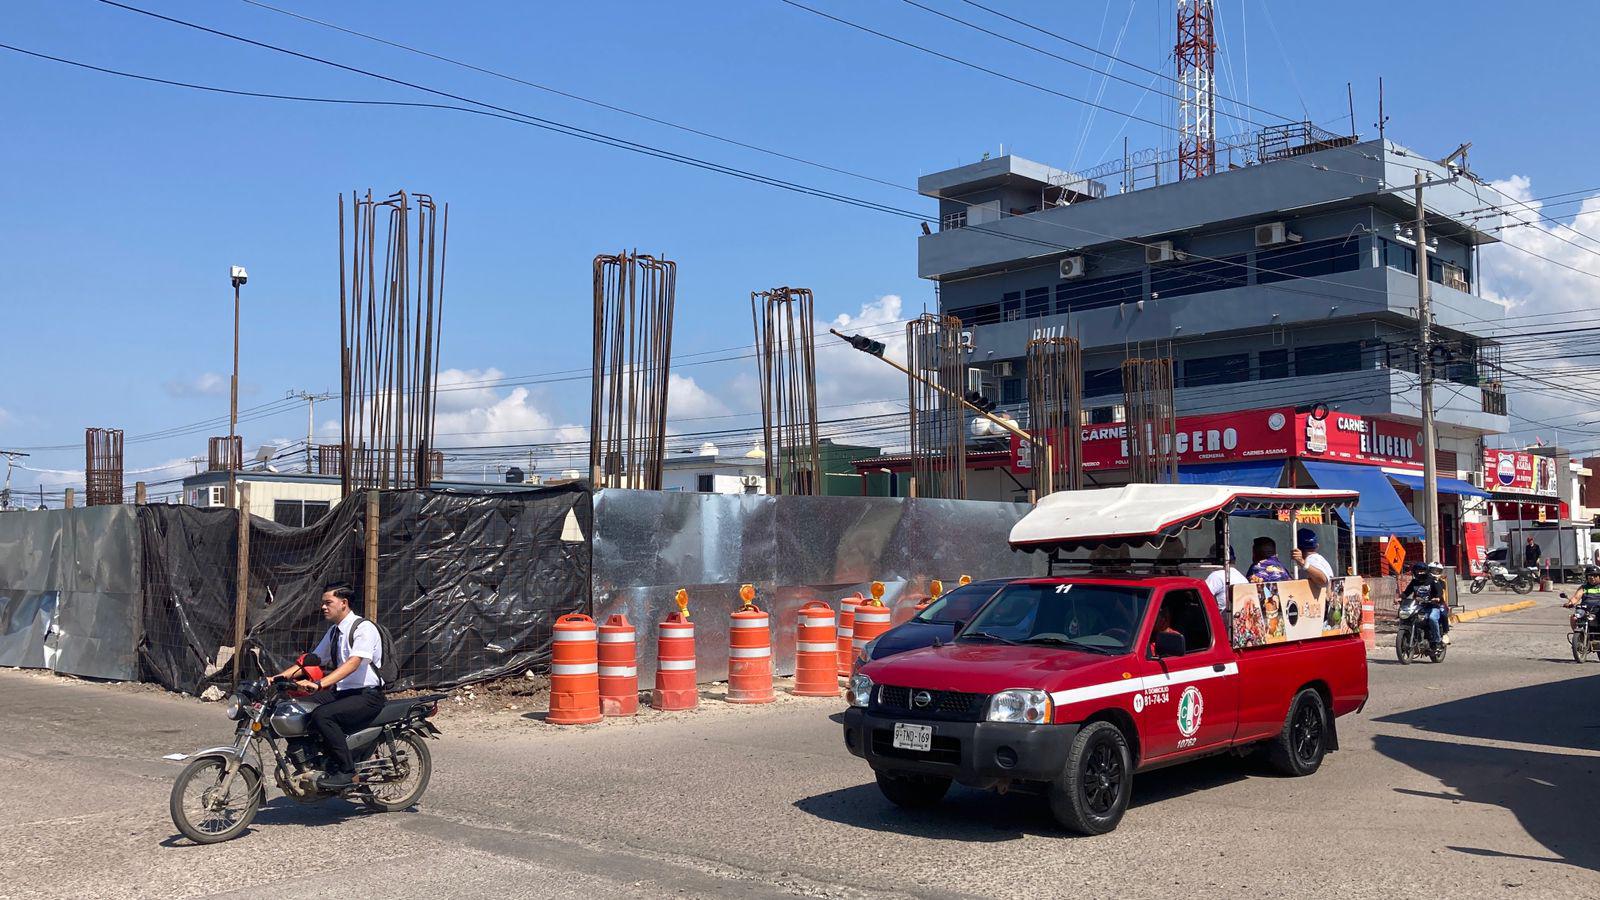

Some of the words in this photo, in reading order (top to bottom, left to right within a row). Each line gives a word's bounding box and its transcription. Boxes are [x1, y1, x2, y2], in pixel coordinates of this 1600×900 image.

[1338, 417, 1368, 433] CARNES
[1361, 434, 1371, 453] EL
[1372, 421, 1412, 458] LUCERO
[1055, 584, 1073, 594] 11
[1136, 698, 1141, 708] 11
